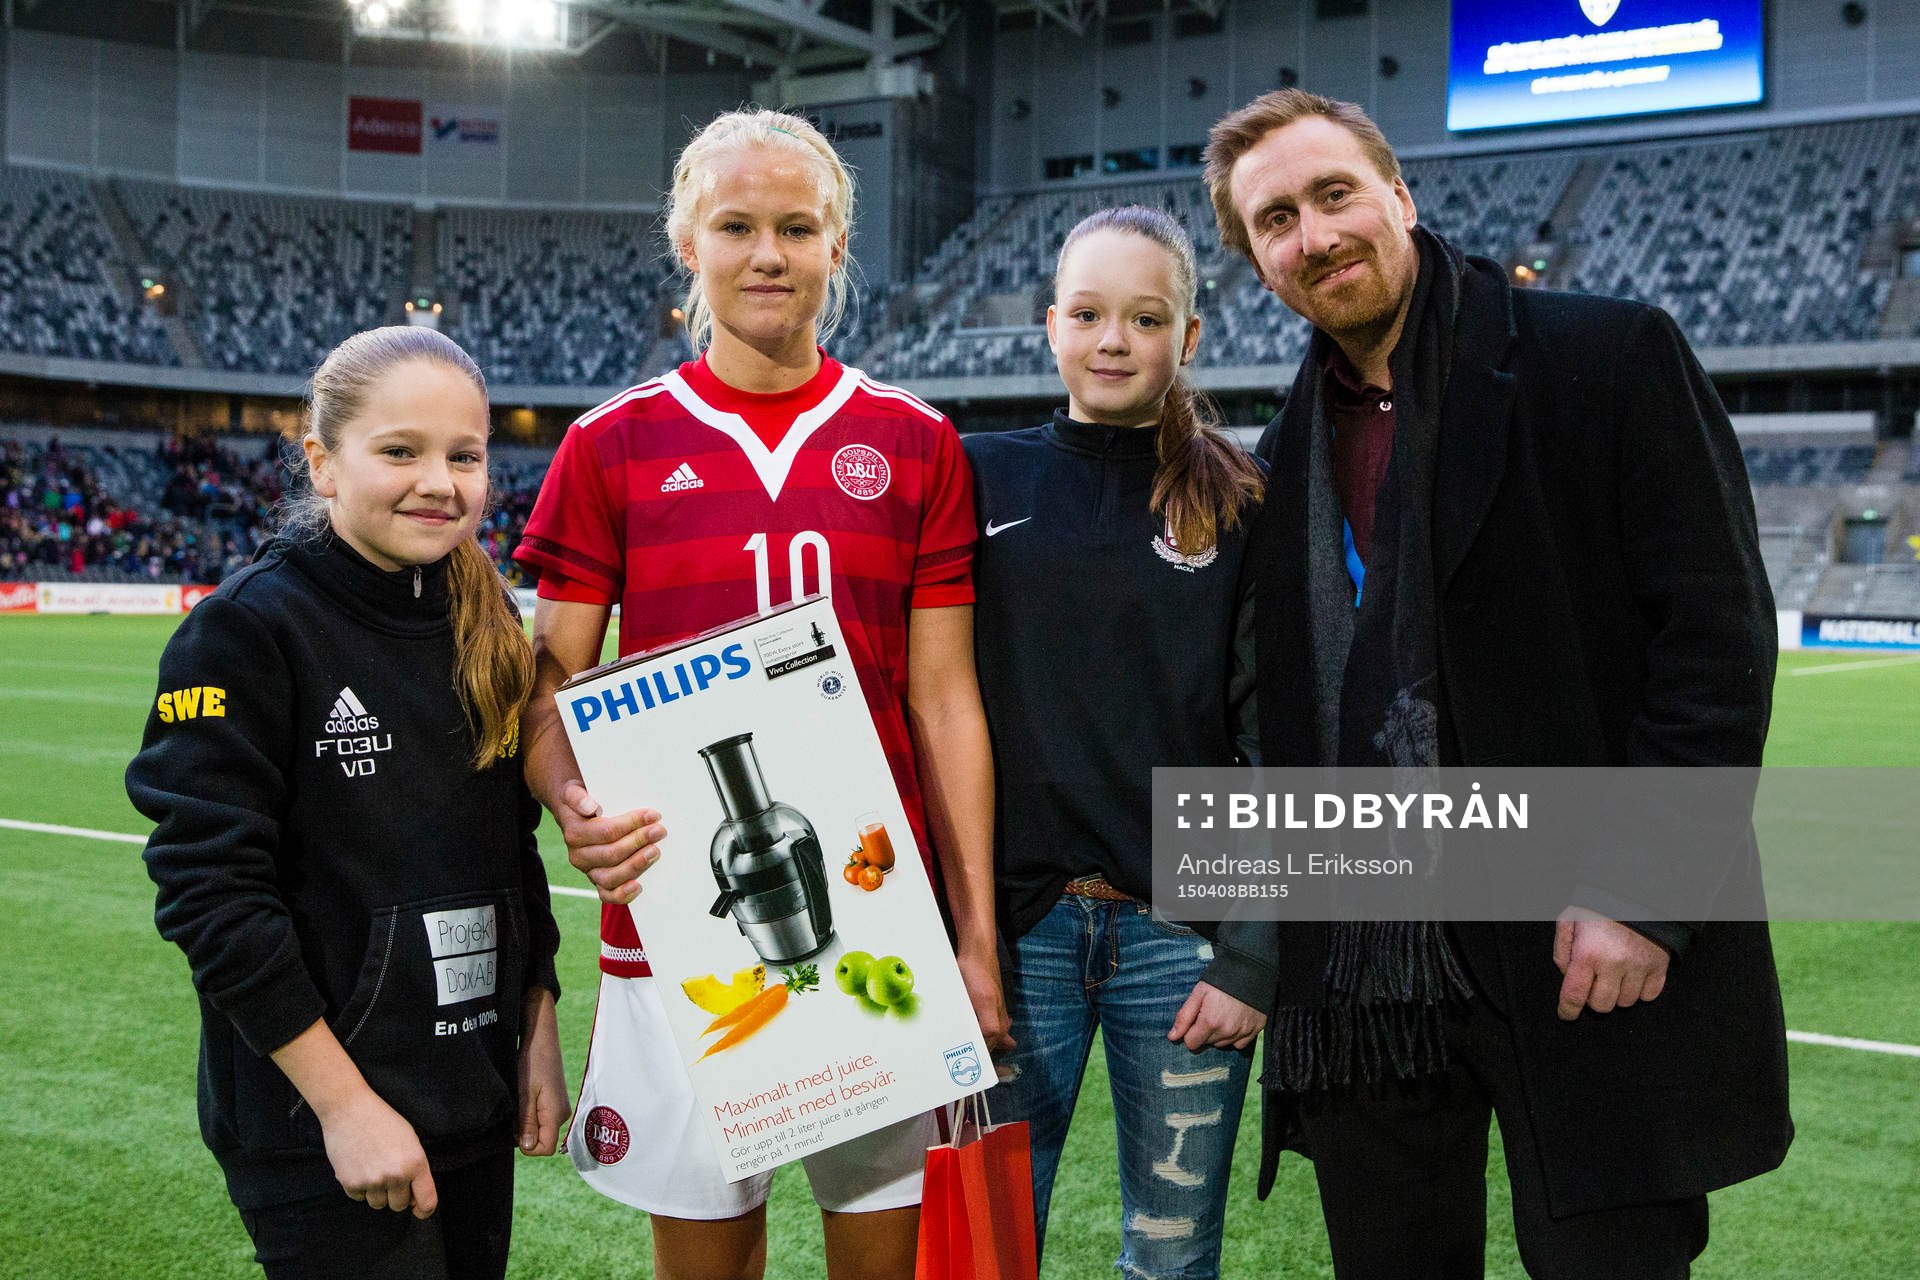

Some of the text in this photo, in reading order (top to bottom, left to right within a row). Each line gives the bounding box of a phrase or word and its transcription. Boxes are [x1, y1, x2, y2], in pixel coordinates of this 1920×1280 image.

[845, 462, 877, 479] DBU
[661, 478, 704, 493] adidas
[742, 530, 834, 614] 10
[1173, 564, 1195, 574] NACKA
[768, 666, 784, 676] Viva
[785, 654, 818, 670] Collection
[571, 643, 751, 733] PHILIPS
[826, 678, 836, 689] 2
[157, 686, 226, 723] SWE
[325, 716, 380, 733] adidas
[340, 758, 376, 778] VD
[437, 914, 494, 952] Projekt
[435, 1021, 458, 1036] En
[478, 1009, 498, 1027] 100%
[945, 1045, 973, 1060] PHILIPS
[713, 1055, 878, 1121] Maximalt med juice.
[723, 1071, 896, 1144] Minimalt med besvär.
[593, 1124, 619, 1147] DBU
[730, 1094, 889, 1159] Gör upp till 2 liter juice åt gången
[735, 1131, 825, 1172] rengör på 1 minut!
